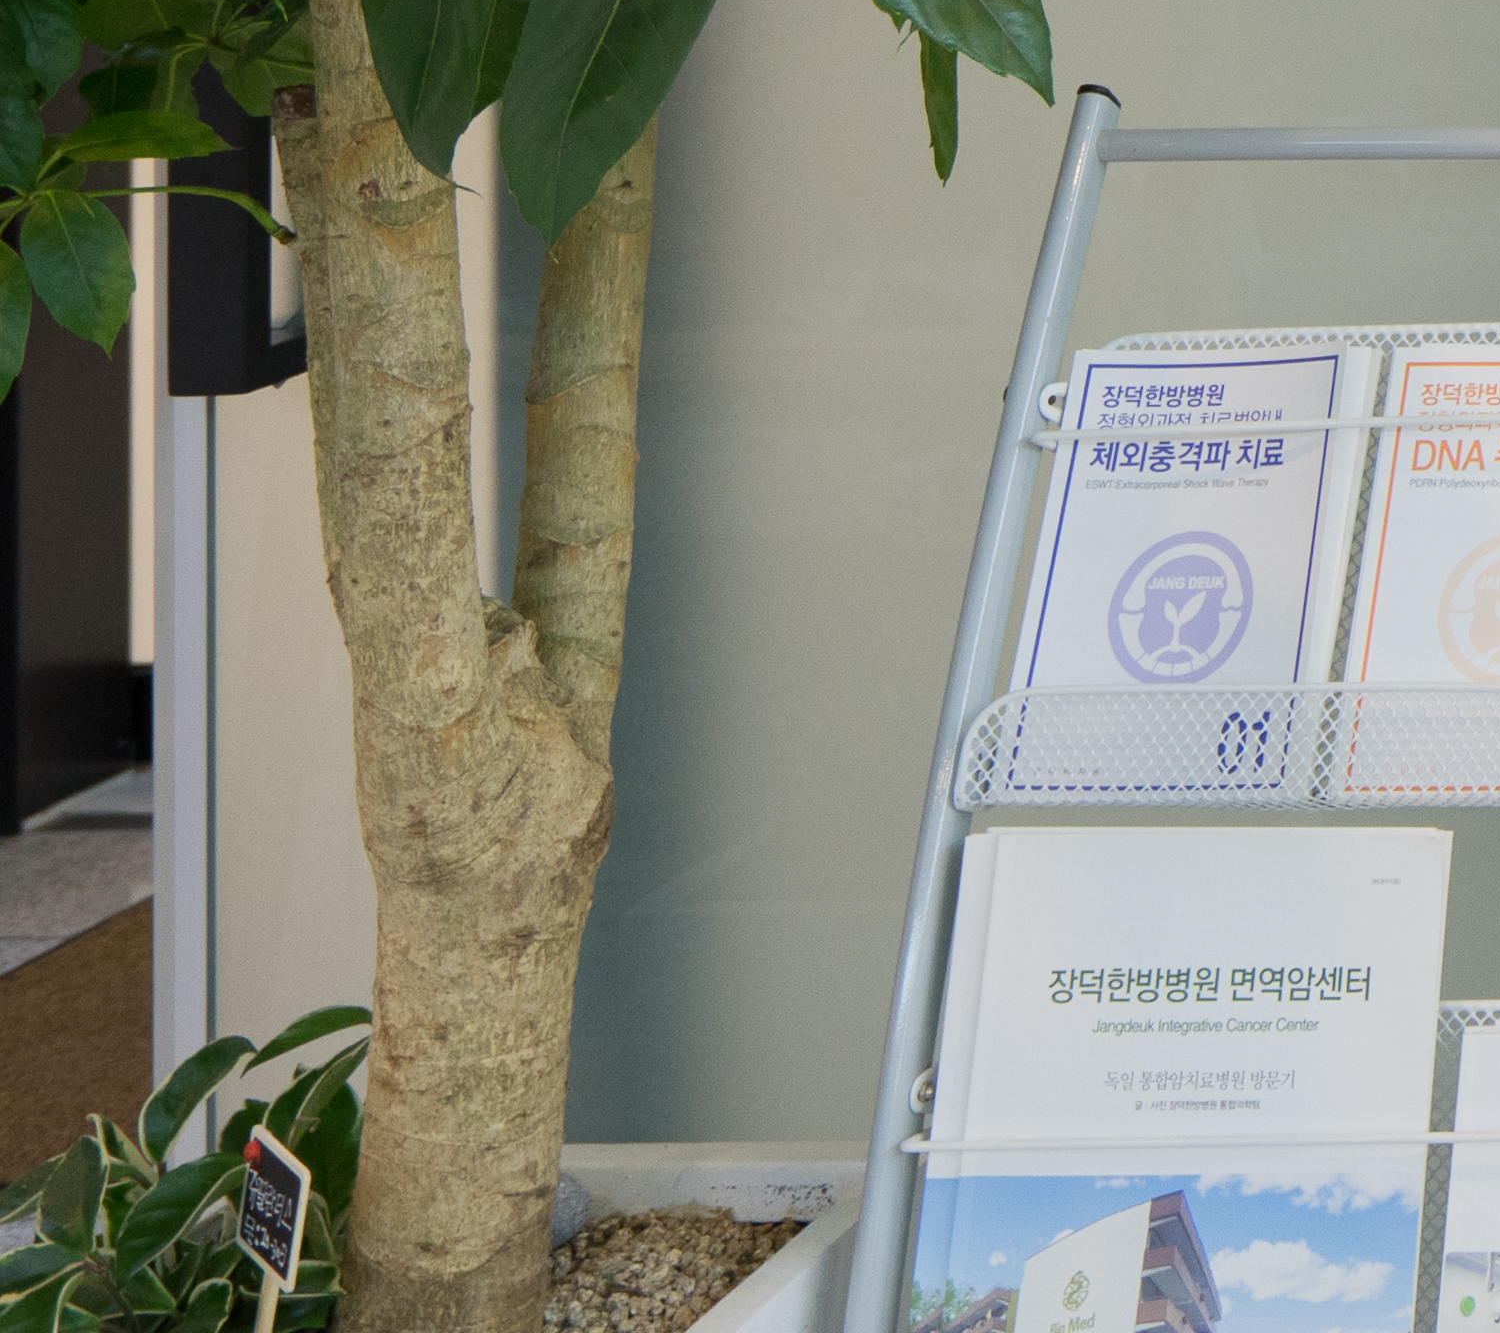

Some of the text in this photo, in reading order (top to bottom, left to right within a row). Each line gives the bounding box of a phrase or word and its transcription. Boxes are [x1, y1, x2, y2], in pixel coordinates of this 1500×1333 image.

[1102, 383, 1226, 409] 장덕한방병원
[1089, 438, 1285, 473] 체외충격파 치료
[1411, 439, 1485, 472] DNA
[1147, 575, 1226, 591] JANG DEUK
[1217, 711, 1271, 775] 01
[1048, 966, 1372, 1005] 장덕한방병원 면역암센터
[1092, 1016, 1320, 1037] Jangdeuk Integrative Cancer Center
[1104, 1068, 1296, 1092] 독일 통합암치료병원 방문기
